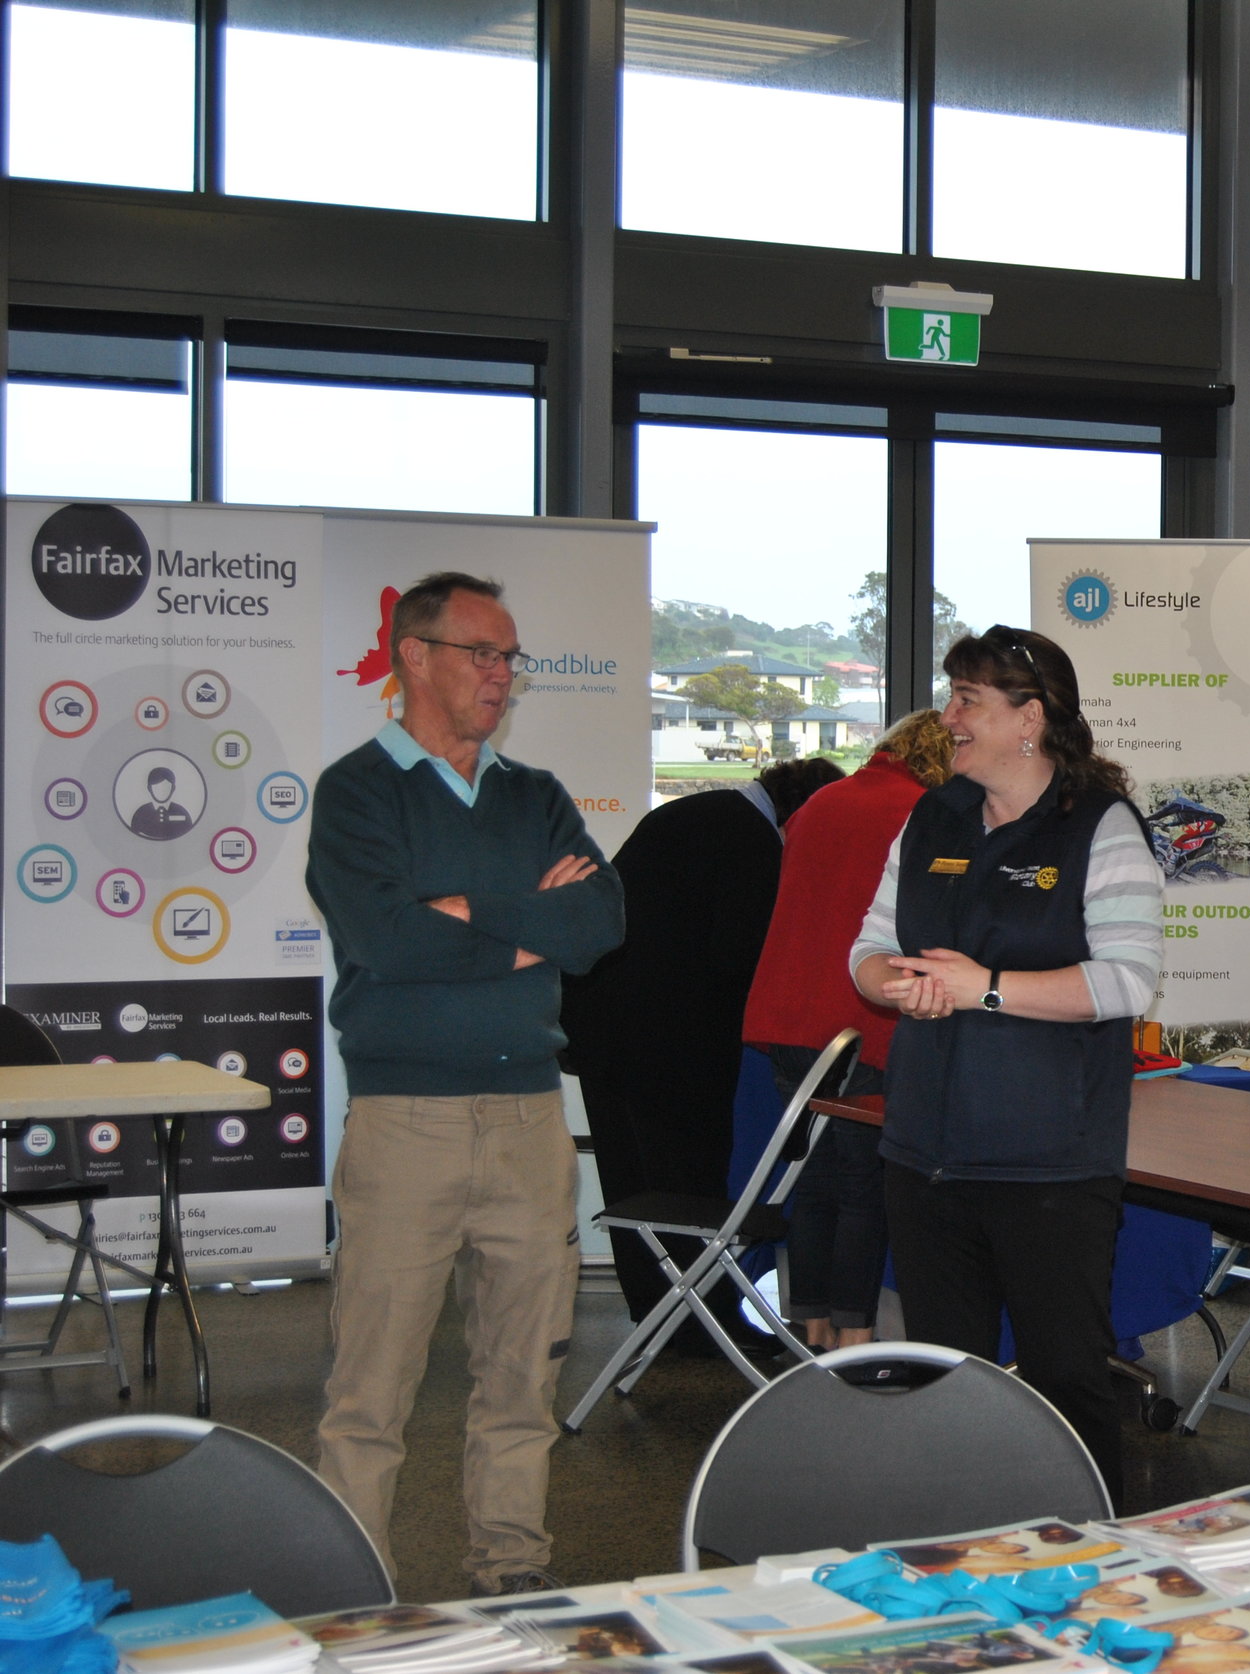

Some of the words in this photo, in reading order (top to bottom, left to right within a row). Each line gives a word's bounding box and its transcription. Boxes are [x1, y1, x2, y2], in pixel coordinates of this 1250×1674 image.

[41, 545, 143, 576] Fairfax
[157, 549, 297, 588] Marketing
[157, 586, 269, 616] Services
[1073, 588, 1100, 612] ajl
[1124, 591, 1201, 612] Lifestyle
[32, 631, 54, 644] The
[56, 631, 73, 644] full
[75, 633, 102, 645] circle
[105, 634, 159, 649] marketing
[161, 635, 203, 647] solution
[206, 635, 221, 647] for
[223, 638, 246, 650] your
[249, 637, 296, 649] business.
[524, 654, 617, 675] ondblue
[1112, 673, 1200, 687] SUPPLIER
[1205, 674, 1229, 688] OF
[524, 683, 578, 693] Depression.
[580, 683, 618, 694] Anxiety.
[1080, 697, 1112, 708] maha
[1087, 719, 1113, 728] man
[1117, 717, 1137, 728] 4x4
[1095, 738, 1115, 749] rior
[1117, 738, 1183, 752] Engineering
[274, 791, 292, 799] SEO
[573, 797, 627, 812] ence.
[37, 866, 59, 875] SEM
[1163, 905, 1187, 918] UR
[1164, 925, 1199, 938] EDS
[1172, 970, 1231, 981] equipment
[122, 1013, 146, 1022] Fairfax
[149, 1013, 183, 1023] Marketing
[203, 1014, 227, 1023] Local
[229, 1012, 257, 1023] Leads.
[259, 1012, 278, 1022] Real
[280, 1011, 313, 1021] Results.
[149, 1022, 177, 1030] Services
[89, 1161, 121, 1169] Reputation
[188, 1207, 206, 1219] 664
